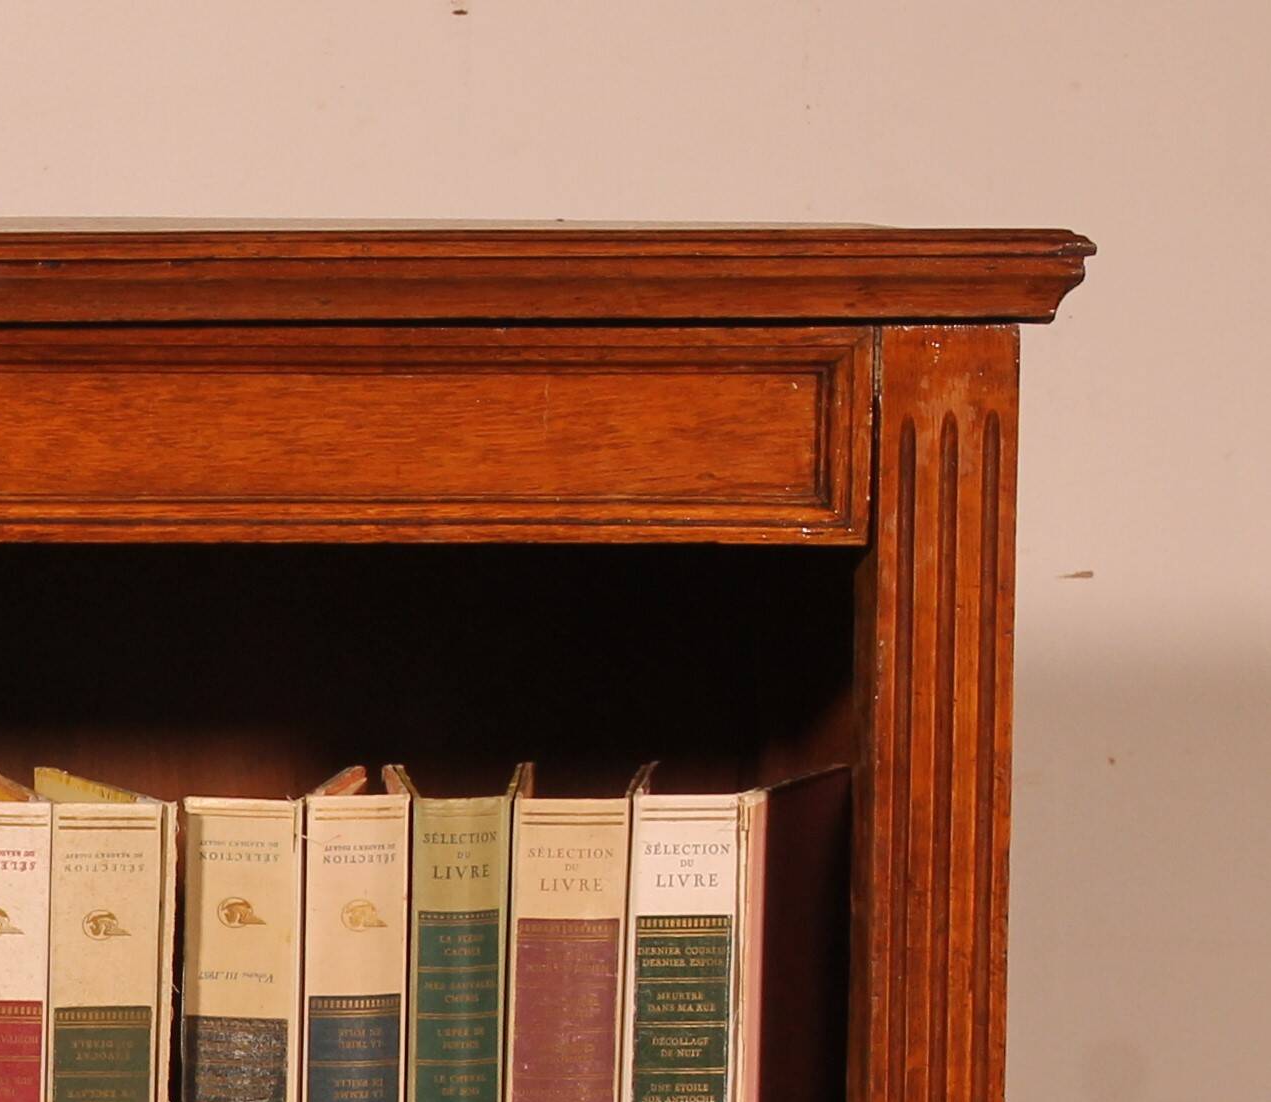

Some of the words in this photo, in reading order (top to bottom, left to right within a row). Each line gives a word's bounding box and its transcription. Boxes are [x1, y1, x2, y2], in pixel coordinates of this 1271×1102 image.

[422, 830, 498, 845] SÉLECTION
[527, 846, 614, 859] SÉLECTION
[644, 841, 730, 856] SÉLECTION
[198, 851, 281, 862] SÉLECTION
[322, 853, 397, 864] SÉLECTION
[457, 851, 471, 859] DU
[564, 864, 579, 872] DU
[679, 859, 694, 868] DU
[63, 863, 145, 875] SÉLECTION
[433, 863, 491, 880] LIVRE
[538, 878, 603, 892] LIVRE
[655, 873, 719, 888] LIVRE
[638, 946, 681, 956] DERNIER
[642, 959, 687, 968] DERNIER
[656, 991, 704, 1001] MEURTRE
[647, 1004, 675, 1013] DANS
[677, 1004, 693, 1012] MA
[694, 1003, 716, 1012] RUE
[660, 1048, 674, 1057] DE
[676, 1048, 703, 1057] NUIT
[650, 1084, 671, 1092] UNE
